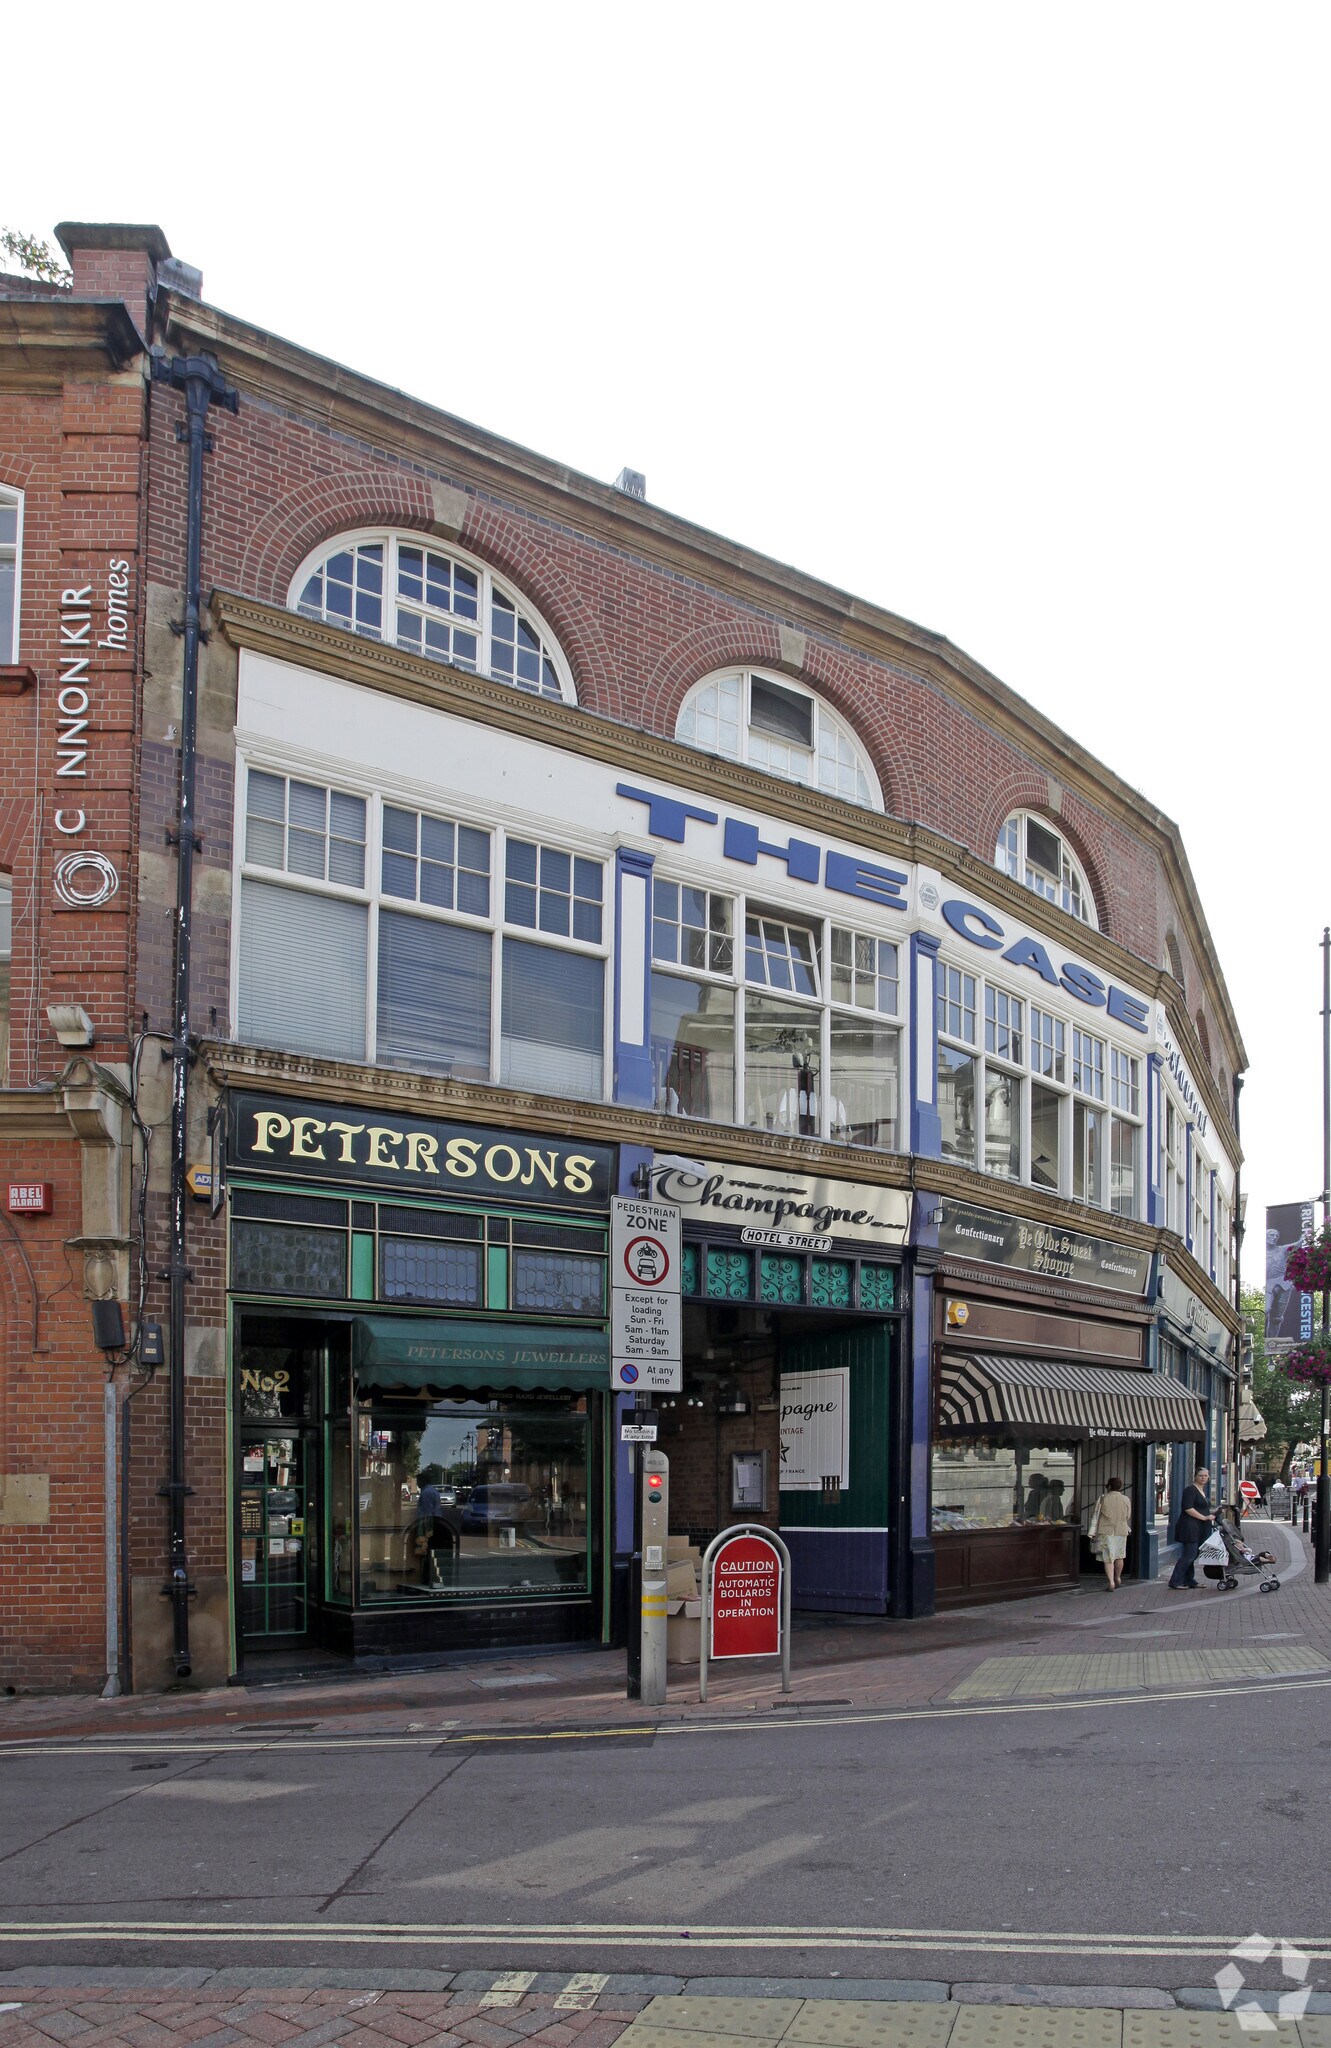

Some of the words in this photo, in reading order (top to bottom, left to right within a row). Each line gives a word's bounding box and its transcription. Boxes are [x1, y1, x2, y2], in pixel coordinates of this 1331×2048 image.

[98, 558, 130, 650] homes
[616, 782, 909, 911] THE
[941, 899, 1150, 1035] CASE
[251, 1111, 596, 1194] PETERSONS
[10, 1187, 42, 1199] ABEL
[656, 1163, 873, 1232] Champagne
[11, 1198, 42, 1207] ALARM
[617, 1202, 676, 1218] PEDESTRIAN
[626, 1214, 668, 1233] ZONE
[746, 1230, 783, 1245] HOTEL
[787, 1236, 828, 1250] STREET
[955, 1224, 1005, 1247] Confectionary
[1018, 1225, 1033, 1250] Ye
[1034, 1229, 1060, 1255] Olde
[1060, 1236, 1092, 1261] Sweet
[1033, 1249, 1075, 1277] Shoppe
[1100, 1259, 1137, 1278] Confectionary
[625, 1294, 653, 1305] Except
[656, 1296, 668, 1305] for
[632, 1305, 662, 1316] loading
[630, 1315, 647, 1324] Sun
[653, 1317, 664, 1325] Fri
[625, 1325, 643, 1334] 5am
[651, 1327, 669, 1336] 11am
[629, 1335, 665, 1346] Saturday
[407, 1346, 505, 1361] PETERSONS
[512, 1351, 607, 1365] JEWELLERS
[625, 1345, 643, 1354] 5am
[651, 1346, 669, 1355] 9am
[647, 1366, 656, 1374] At
[659, 1368, 674, 1376] any
[651, 1377, 670, 1385] time
[720, 1560, 774, 1571] CAUTION
[718, 1578, 775, 1588] AUTOMATIC
[720, 1588, 771, 1598] BOLLARDS
[740, 1599, 752, 1607] IN
[717, 1607, 774, 1618] OPERATION
